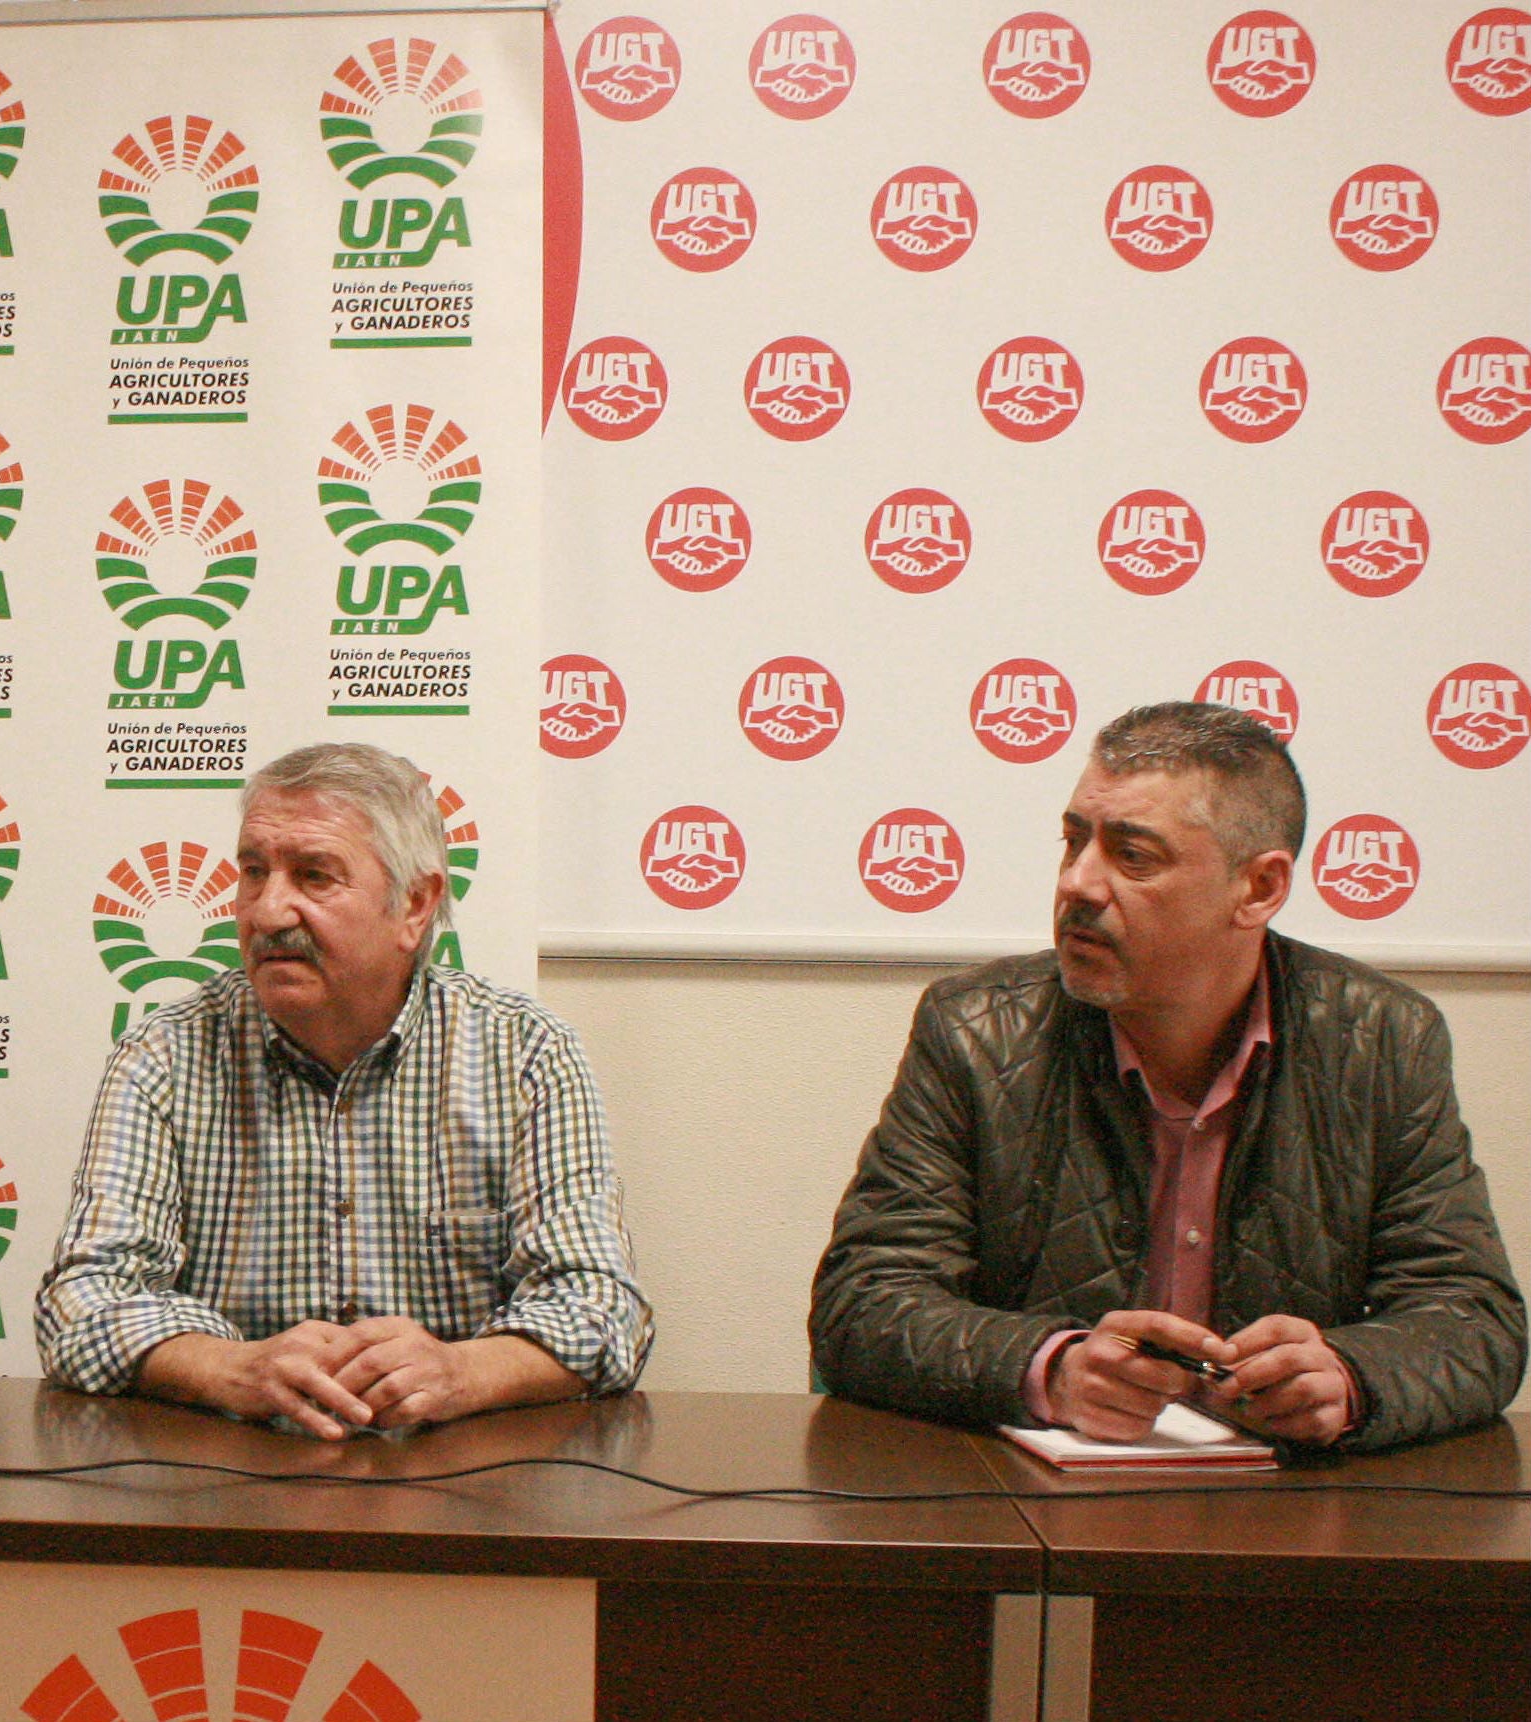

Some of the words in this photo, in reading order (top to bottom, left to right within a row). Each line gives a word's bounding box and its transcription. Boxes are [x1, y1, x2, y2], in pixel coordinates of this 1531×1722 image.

[588, 30, 665, 66] UGT
[763, 31, 840, 66] UGT
[996, 28, 1075, 64] UGT
[1220, 26, 1301, 63] UGT
[1460, 24, 1531, 61] UGT
[663, 183, 741, 218] UGT
[884, 182, 962, 217] UGT
[1119, 181, 1198, 217] UGT
[1343, 180, 1424, 216] UGT
[339, 196, 472, 249] UPA
[116, 273, 248, 325] UPA
[331, 296, 474, 312] AGRICULTORES
[332, 282, 374, 294] Unión
[379, 281, 398, 294] de
[402, 280, 473, 295] Pequeños
[335, 322, 342, 334] y
[350, 314, 470, 330] GANADEROS
[108, 372, 249, 389] AGRICULTORES
[110, 358, 152, 370] Unión
[157, 357, 174, 369] de
[179, 356, 249, 371] Pequeños
[575, 352, 652, 387] UGT
[757, 352, 835, 387] UGT
[990, 352, 1069, 388] UGT
[1213, 352, 1292, 388] UGT
[1450, 352, 1530, 389] UGT
[112, 397, 120, 409] y
[128, 390, 247, 406] GANADEROS
[658, 503, 736, 538] UGT
[878, 504, 956, 539] UGT
[1112, 505, 1190, 541] UGT
[1335, 506, 1414, 542] UGT
[336, 565, 470, 616] UPA
[114, 639, 245, 690] UPA
[328, 664, 471, 680] AGRICULTORES
[329, 649, 372, 661] Unión
[377, 648, 395, 661] de
[399, 647, 471, 663] Pequeños
[332, 688, 340, 700] y
[348, 682, 468, 698] GANADEROS
[540, 670, 610, 705] UGT
[752, 672, 829, 707] UGT
[983, 674, 1061, 709] UGT
[1206, 676, 1283, 706] UGT
[1440, 678, 1520, 714] UGT
[106, 738, 247, 753] AGRICULTORES
[107, 723, 149, 734] Unión
[154, 722, 172, 734] de
[176, 722, 247, 737] Pequeños
[110, 762, 118, 774] y
[125, 756, 244, 771] GANADEROS
[653, 822, 730, 856] UGT
[872, 824, 950, 859] UGT
[1326, 830, 1405, 865] UGT
